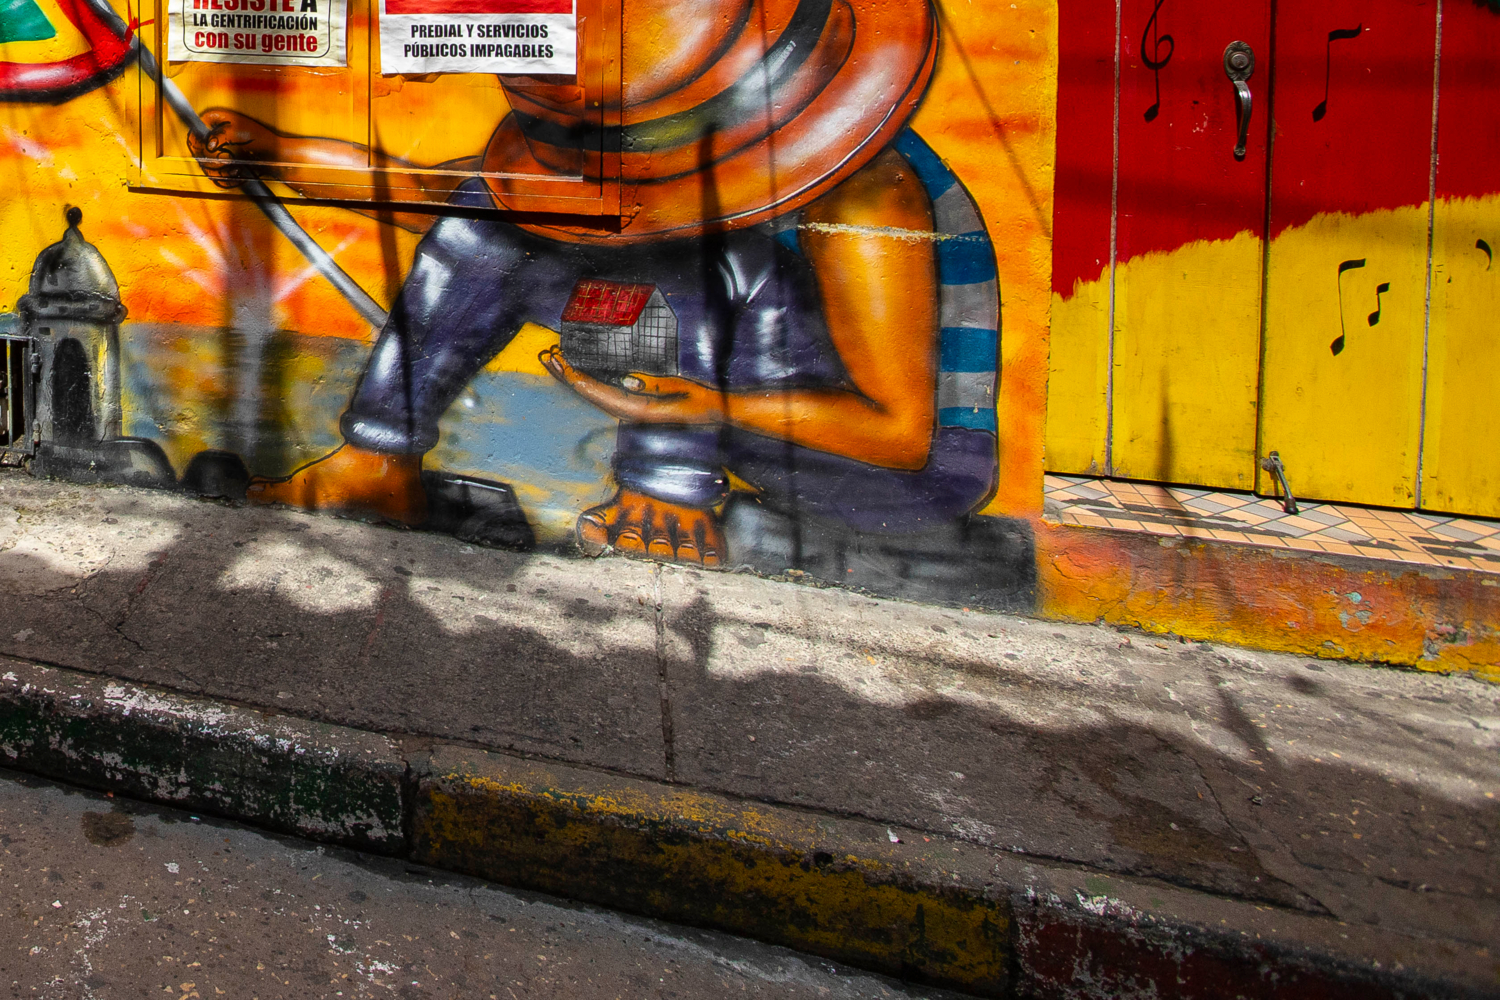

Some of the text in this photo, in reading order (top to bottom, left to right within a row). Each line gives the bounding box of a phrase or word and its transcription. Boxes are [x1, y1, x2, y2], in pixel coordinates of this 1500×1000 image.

[193, 13, 317, 31] LA GENTRIFICACIÓN
[411, 24, 548, 39] PREDIAL Y SERVICIOS
[194, 31, 318, 53] con su gente
[404, 42, 554, 59] PÚBLICOS IMPAGABLES
